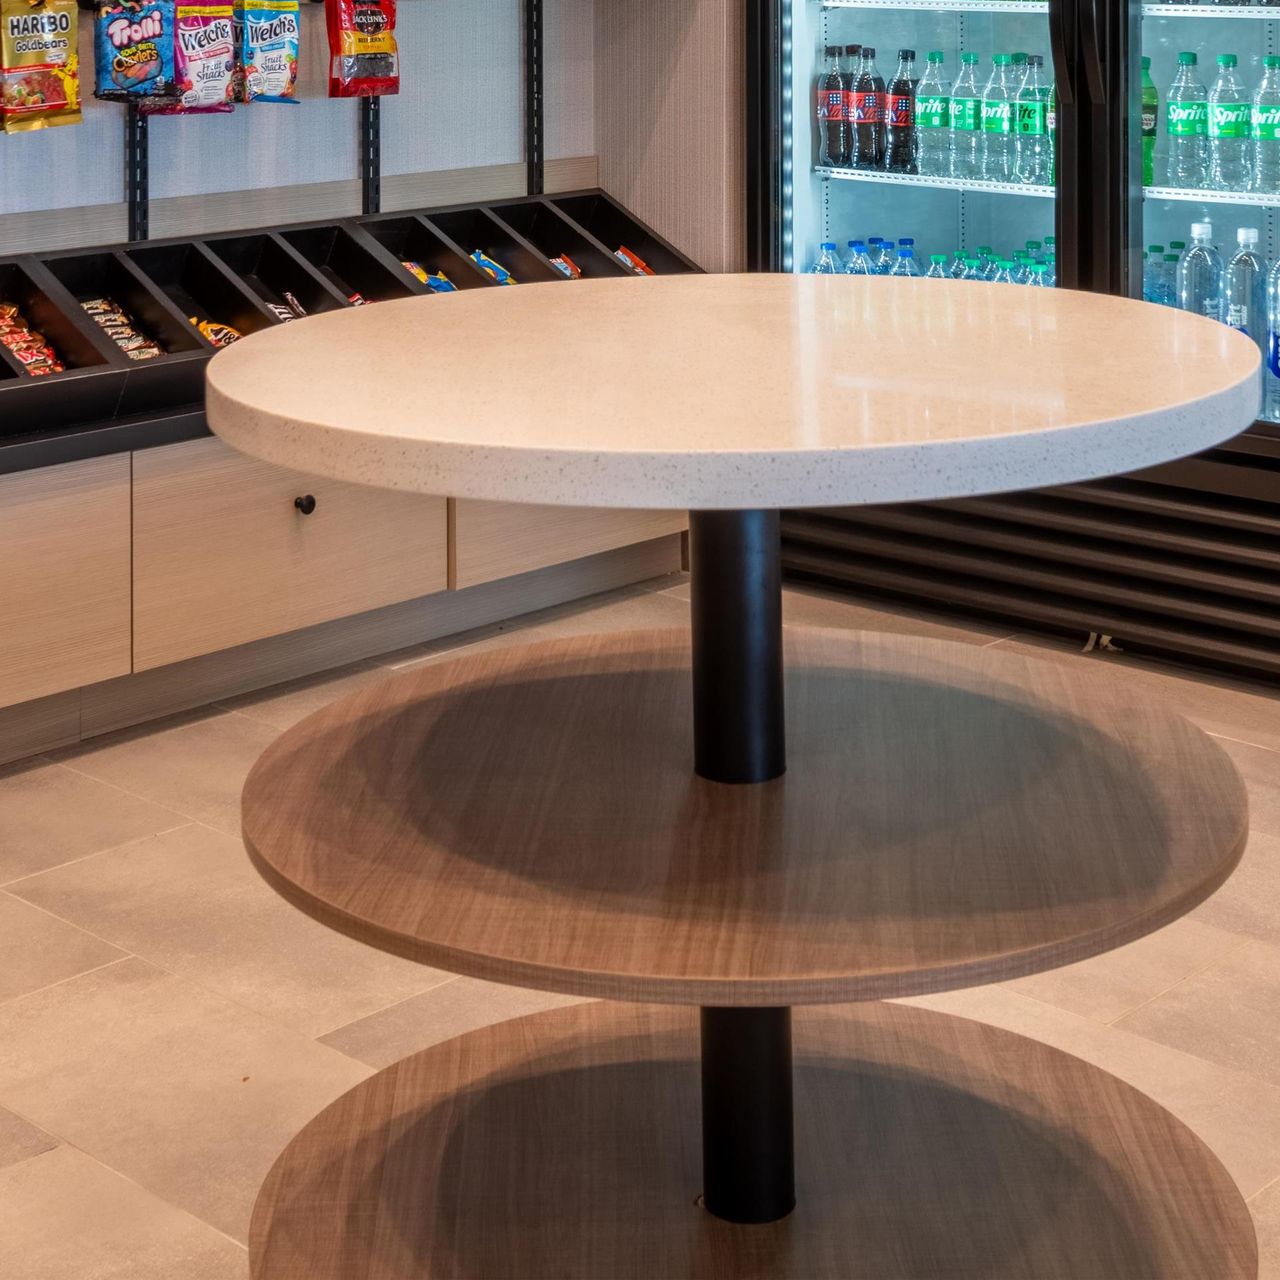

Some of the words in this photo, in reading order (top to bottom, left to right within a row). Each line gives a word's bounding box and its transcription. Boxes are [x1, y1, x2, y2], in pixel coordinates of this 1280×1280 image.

[10, 13, 70, 37] HARIBO
[109, 10, 163, 48] Trolli
[180, 21, 231, 51] Welch's
[249, 16, 296, 44] Welch's
[15, 38, 69, 54] Goldbears
[113, 48, 158, 73] Crawlers
[261, 62, 287, 74] Snacks
[264, 55, 282, 66] Fruit
[196, 70, 225, 84] Snacks
